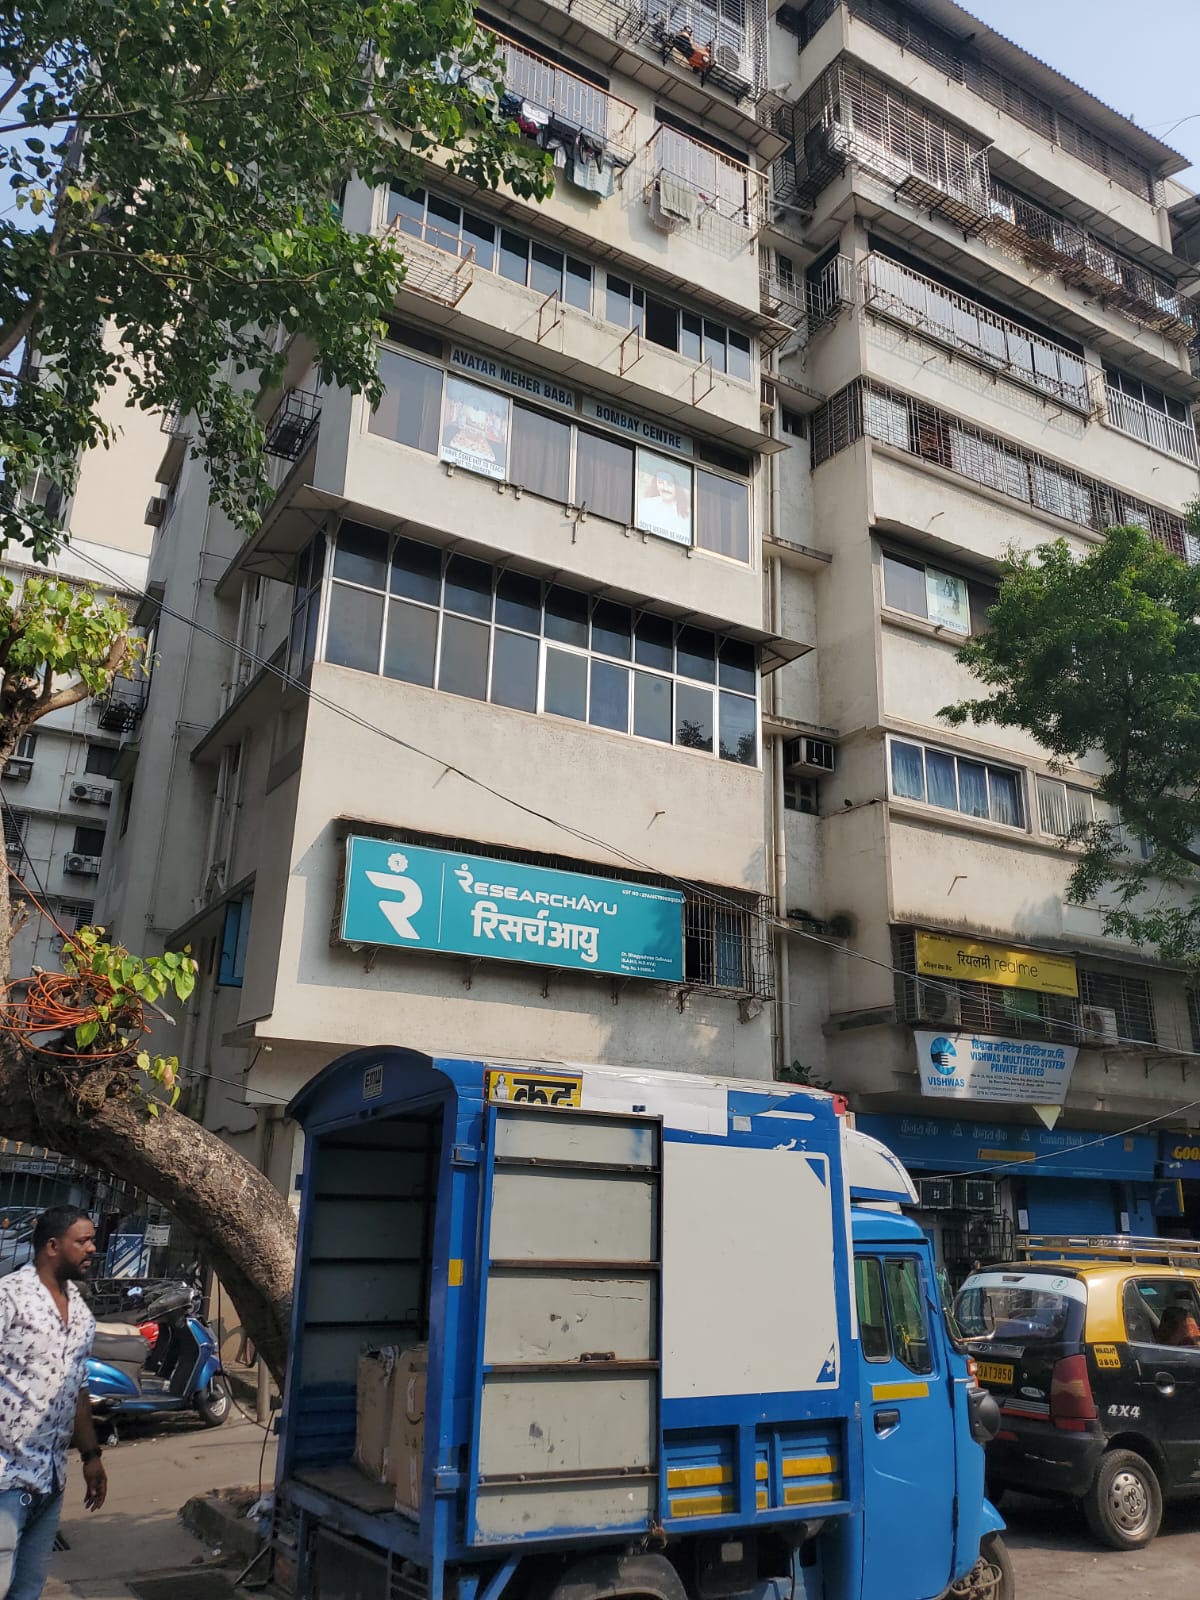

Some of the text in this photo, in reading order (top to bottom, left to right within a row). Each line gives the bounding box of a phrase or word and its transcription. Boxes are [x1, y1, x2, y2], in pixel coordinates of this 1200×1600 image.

[452, 349, 574, 408] AVATAR MEHER BABA
[596, 404, 682, 449] BOMBAY CENTRE
[957, 950, 991, 970] रियलमी
[994, 959, 1039, 978] realme
[970, 1051, 1066, 1070] VISHWAS MULTITECH SYSTEM
[991, 1062, 1045, 1077] PRIVATE LIMITED
[928, 1076, 965, 1088] VISHWAS
[1107, 1404, 1141, 1418] 4X4
